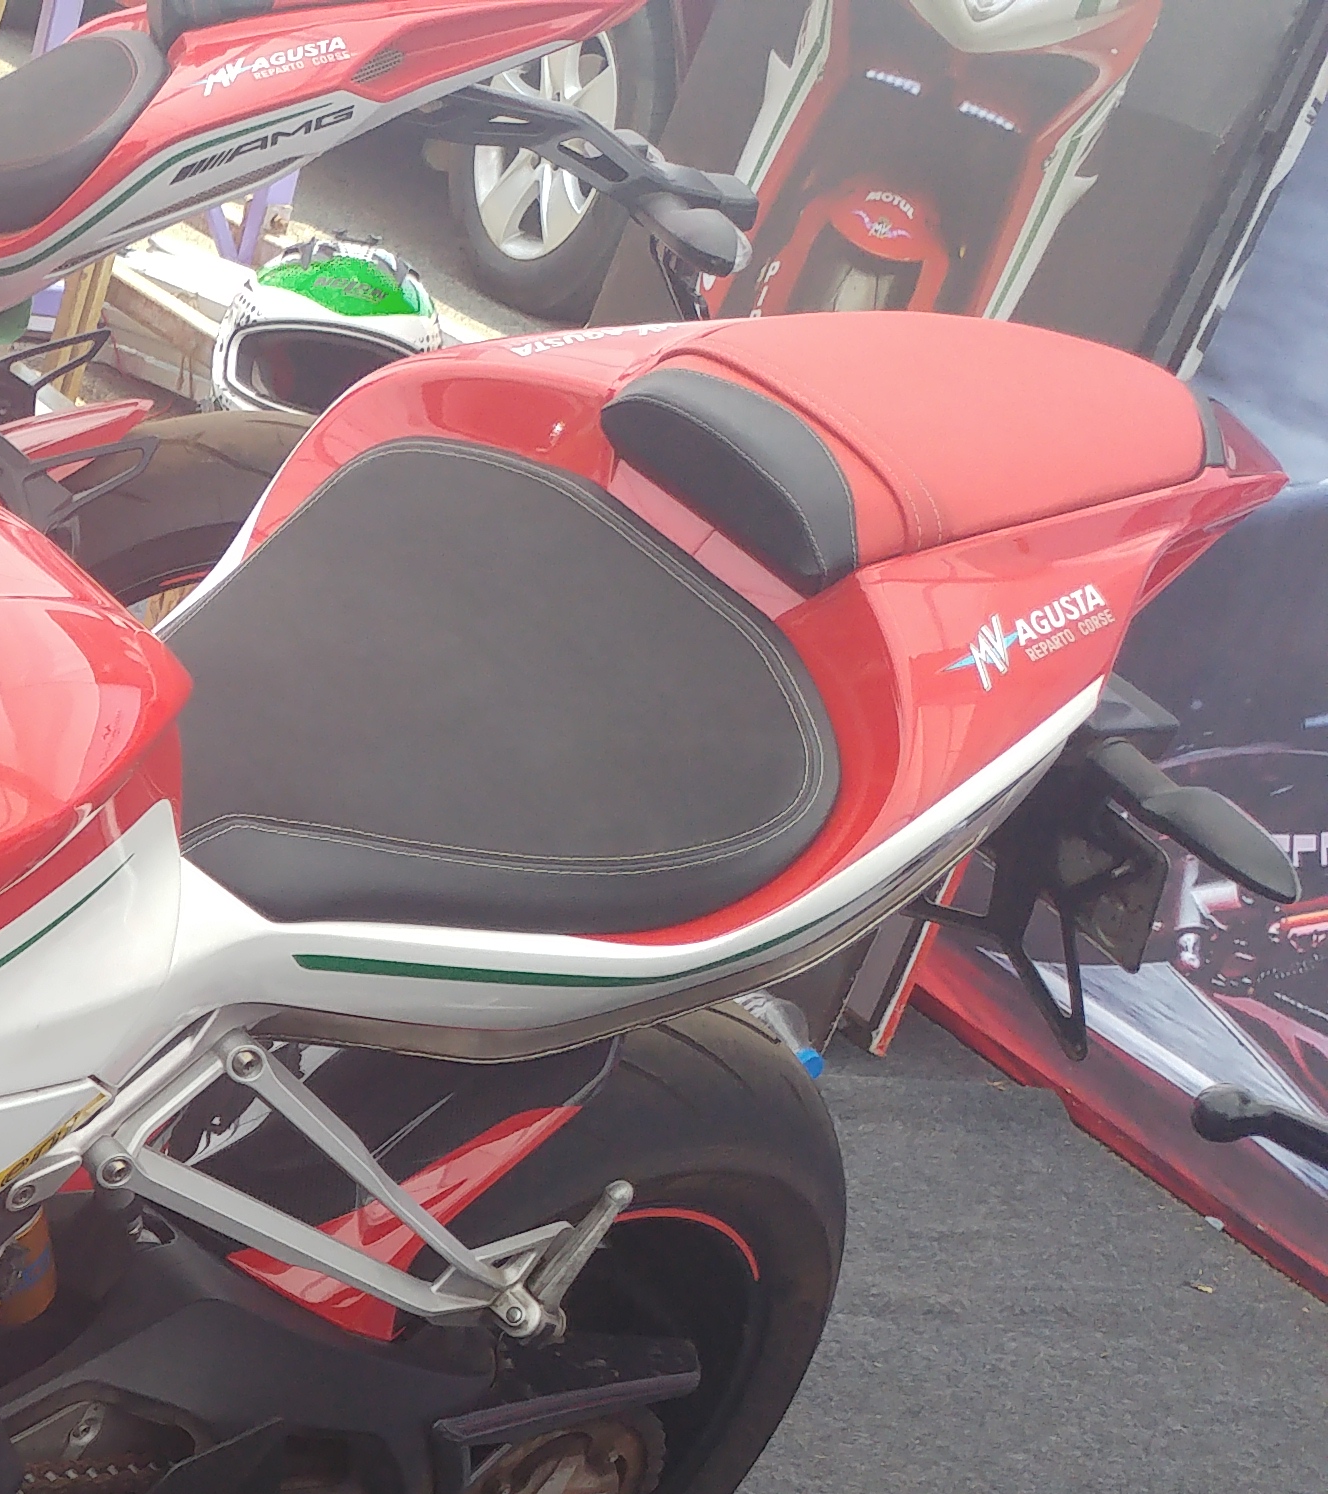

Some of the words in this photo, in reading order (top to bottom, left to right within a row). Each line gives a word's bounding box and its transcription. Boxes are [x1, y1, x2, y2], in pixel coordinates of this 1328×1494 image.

[203, 57, 246, 97] MV
[251, 36, 347, 73] AGUSTA
[252, 61, 305, 81] REPARTO
[864, 191, 915, 220] MOTUL
[969, 613, 1010, 692] MV
[1015, 584, 1106, 647] AGUSTA
[1025, 628, 1076, 662] REPARTO
[1077, 608, 1116, 637] CORSE
